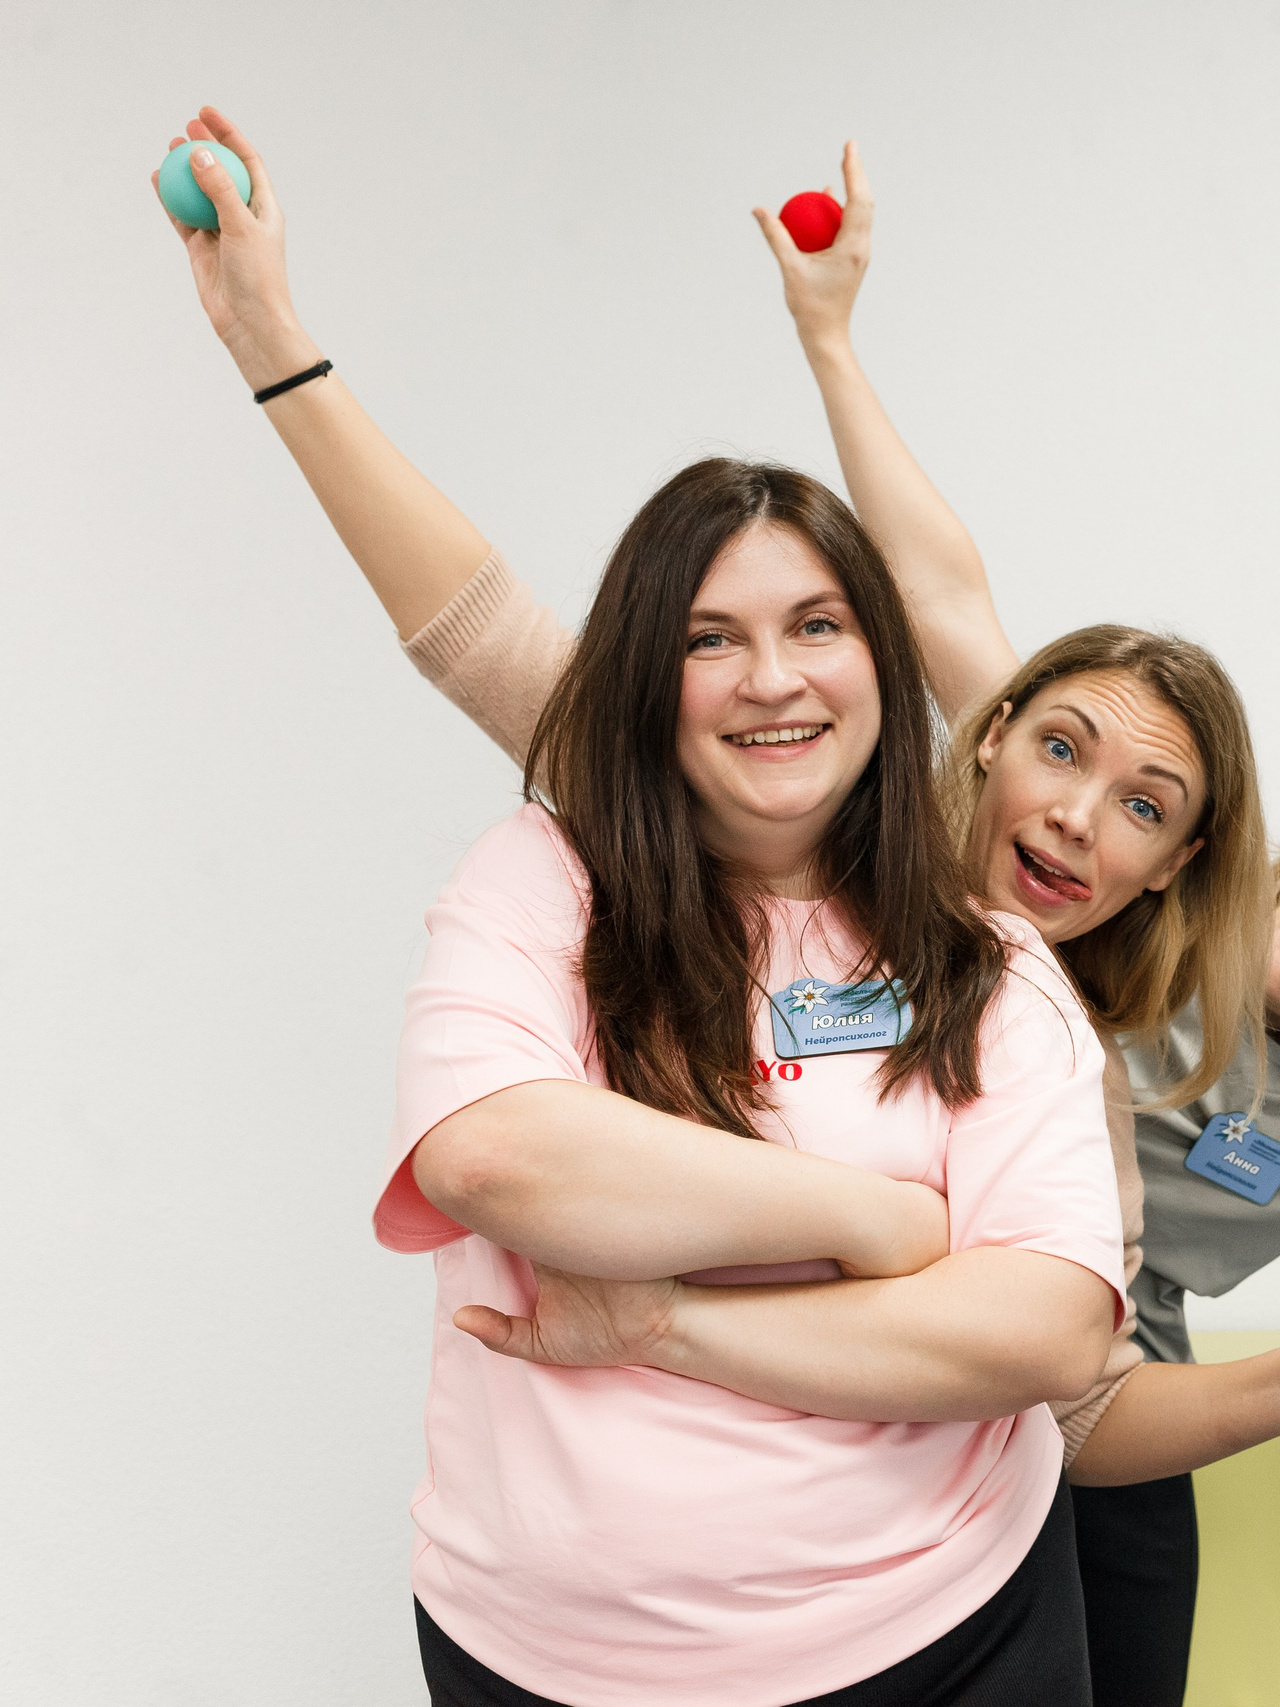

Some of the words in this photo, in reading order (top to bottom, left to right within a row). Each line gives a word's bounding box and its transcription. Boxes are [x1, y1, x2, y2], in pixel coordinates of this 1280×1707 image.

[811, 1012, 874, 1031] Юлия
[804, 1030, 888, 1046] Нейропсихолог
[1222, 1150, 1261, 1176] Анна
